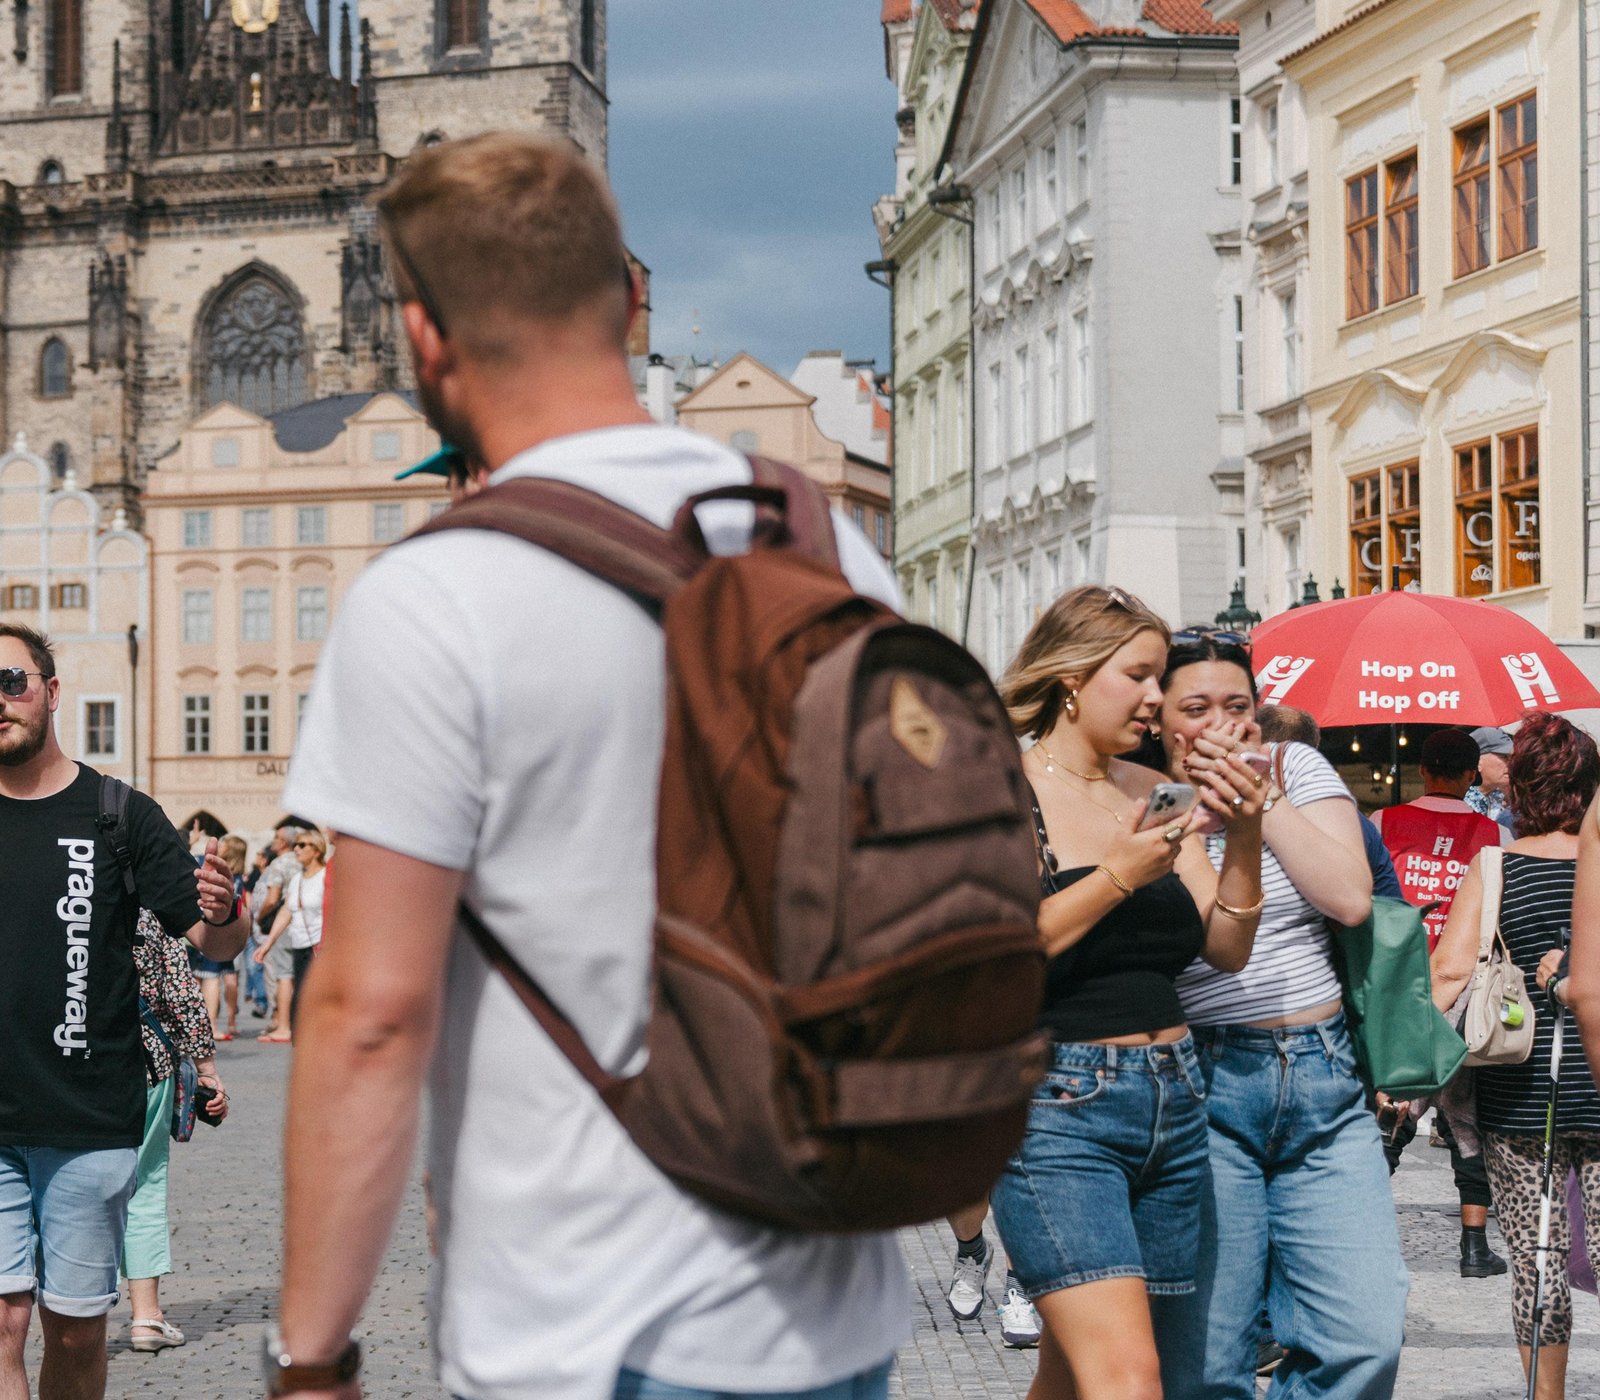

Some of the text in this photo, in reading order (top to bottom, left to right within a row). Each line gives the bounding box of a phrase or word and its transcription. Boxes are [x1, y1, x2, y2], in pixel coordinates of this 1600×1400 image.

[1361, 660, 1456, 682] Hop On
[1358, 690, 1460, 713] Hop Off
[1406, 855, 1442, 875] Hop
[1404, 871, 1440, 891] Hop
[1417, 892, 1432, 900] Bus
[53, 838, 95, 1057] pragueway.
